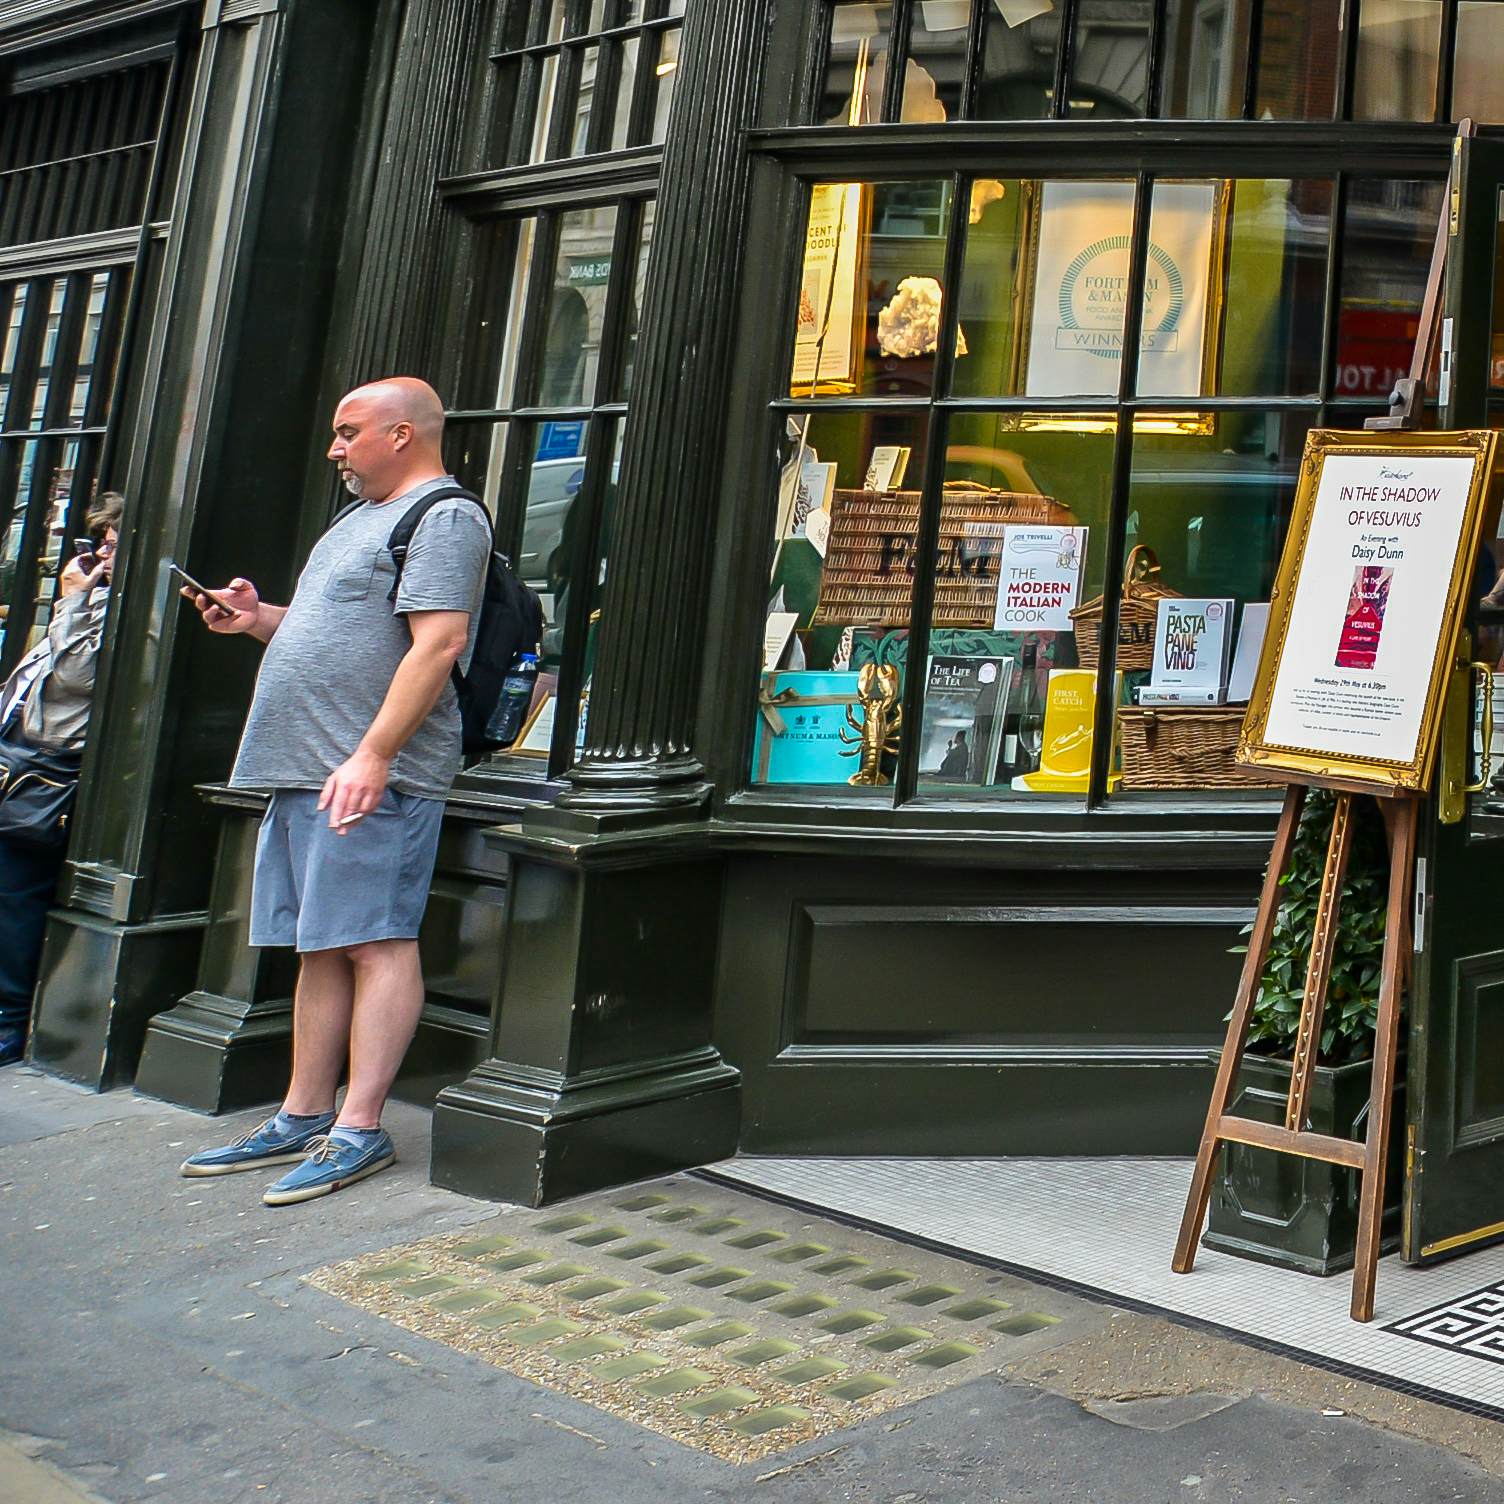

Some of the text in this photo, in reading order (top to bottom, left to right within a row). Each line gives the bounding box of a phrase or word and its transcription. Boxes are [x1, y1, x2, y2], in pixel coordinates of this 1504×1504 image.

[1085, 277, 1159, 290] FORTM
[1088, 291, 1152, 302] & MAN
[1074, 334, 1156, 346] WINNS
[1340, 487, 1440, 502] IN THE SHADOW
[1348, 511, 1422, 527] OF VESUVIUS
[1352, 545, 1404, 562] Daisy Dunn
[1010, 568, 1037, 579] THE
[1008, 582, 1071, 594] MODERN
[1006, 596, 1062, 607] ITALIAN
[1004, 609, 1046, 622] COOK
[1166, 615, 1206, 633] PASTA
[1165, 633, 1198, 651] PANE
[1165, 651, 1196, 670] VINO
